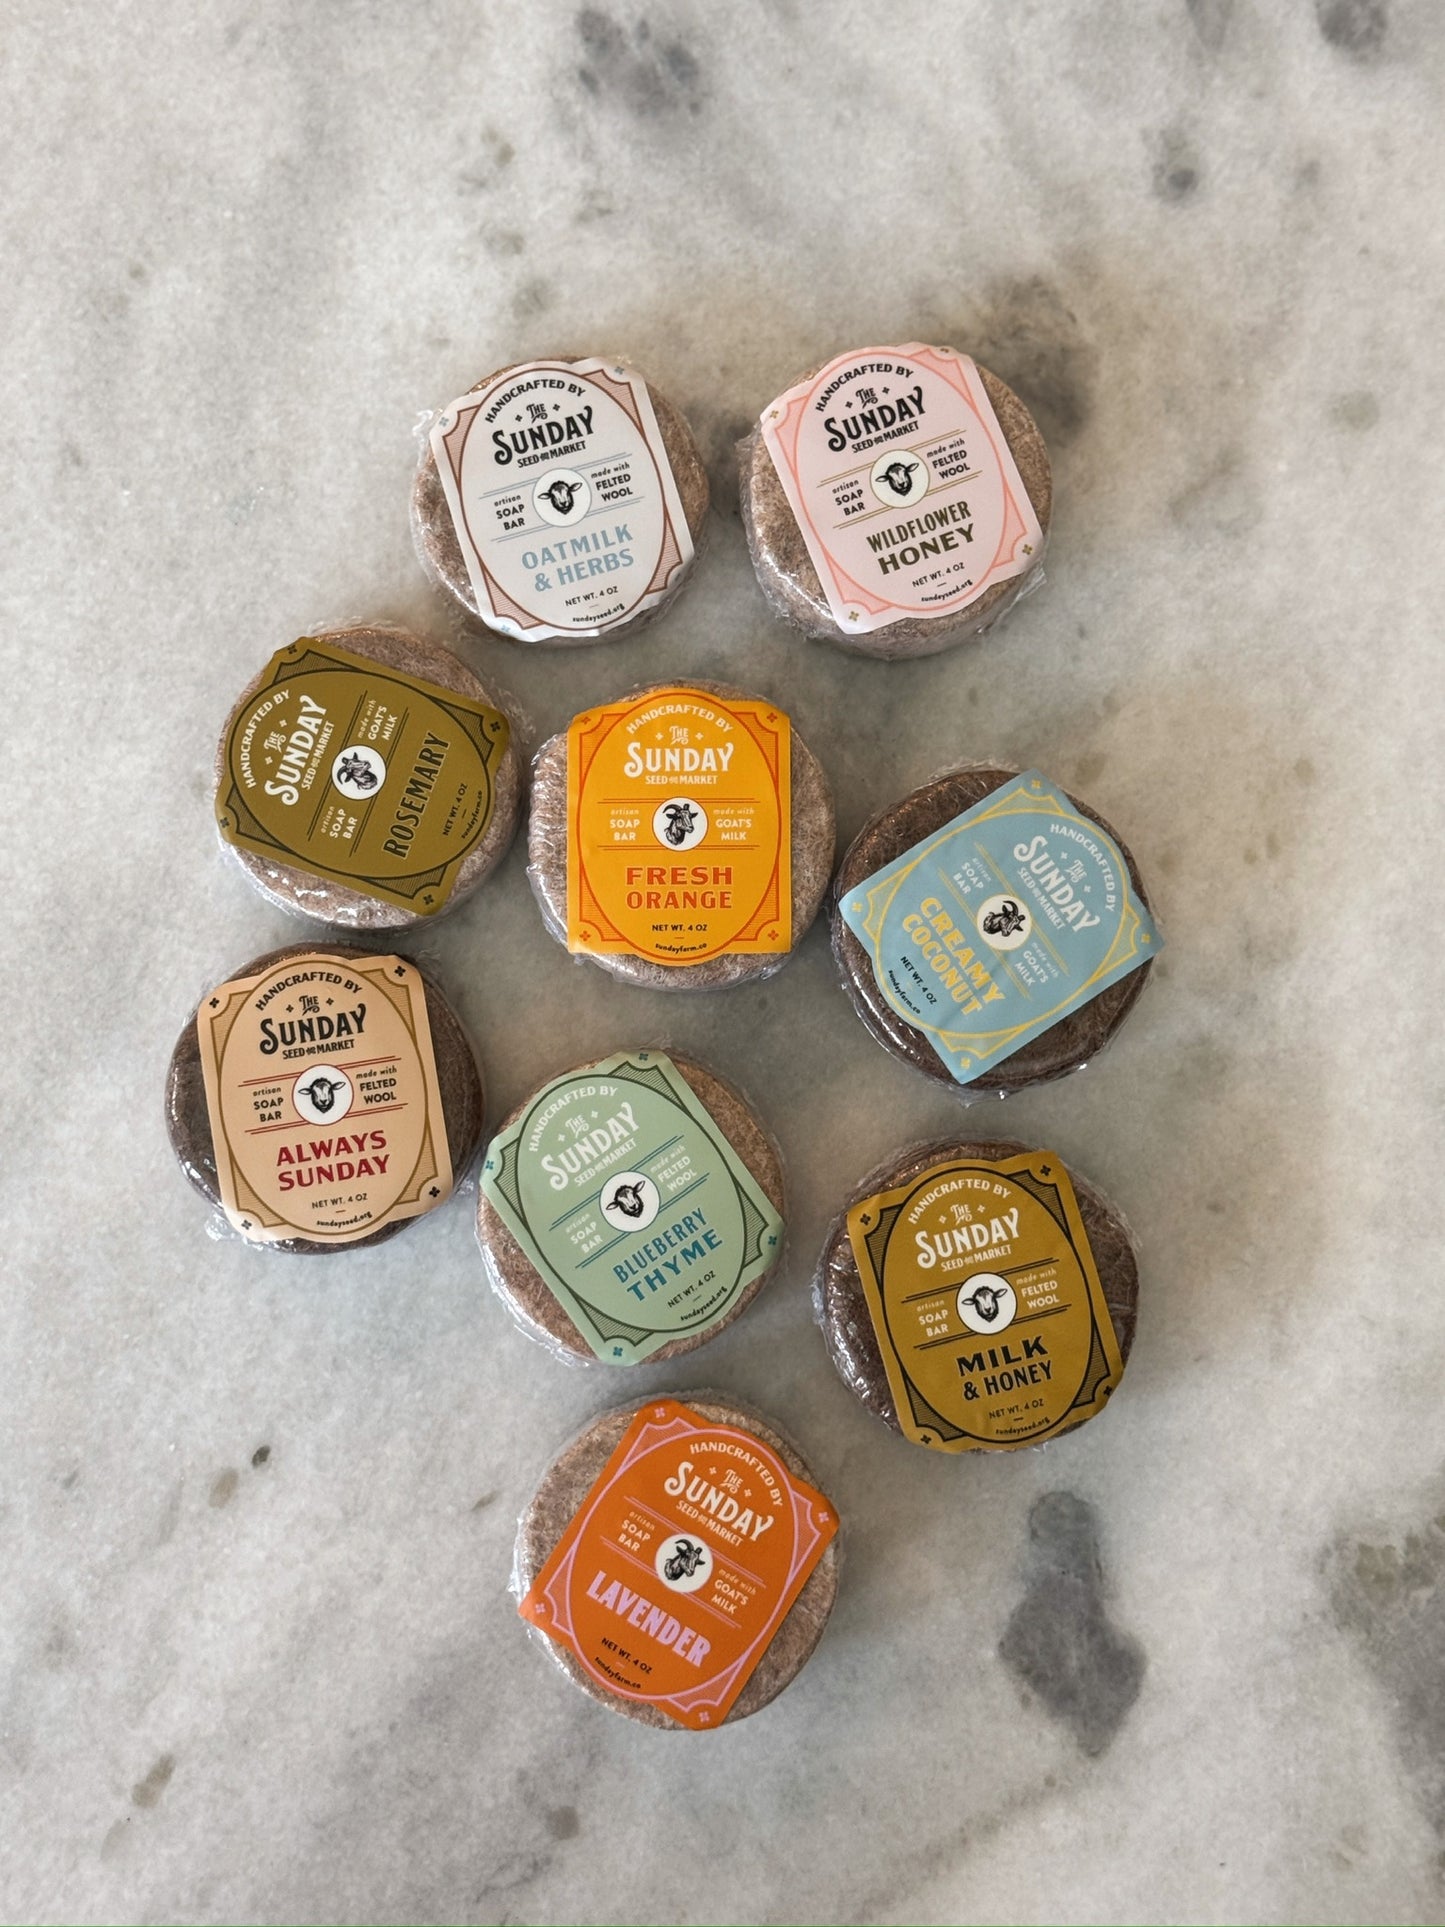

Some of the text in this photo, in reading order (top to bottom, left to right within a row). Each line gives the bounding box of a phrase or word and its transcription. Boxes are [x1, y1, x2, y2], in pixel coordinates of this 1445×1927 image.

[485, 379, 586, 423] HANDCRAFTED BY
[815, 363, 914, 412] HANDCRAFTED BY
[824, 386, 926, 452] SUNDAY
[492, 405, 594, 465] SUNDAY
[851, 439, 874, 453] SEED
[884, 421, 919, 442] MARKET
[517, 454, 540, 468] SEED
[550, 441, 587, 458] MARKET
[932, 450, 967, 468] FELTED
[595, 473, 631, 490] FELTED
[939, 463, 970, 479] WOOL
[601, 487, 633, 502] WOOL
[835, 489, 864, 506] SOAP
[496, 504, 525, 519] SOAP
[843, 502, 866, 516] BAR
[503, 518, 525, 530] BAR
[866, 501, 972, 552] WILDFLOWER
[521, 524, 633, 569] OATMILK
[877, 523, 974, 575] HONEY
[534, 549, 634, 592] & HERBS
[912, 562, 965, 587] NET WT. 4 OZ
[565, 586, 618, 606] NET WT. OZ
[921, 579, 973, 602] sundayseed.org
[572, 604, 625, 623] sundayseed.org
[368, 705, 388, 740] GOAT'S
[382, 715, 398, 740] MILK
[626, 705, 733, 734] HANDCRAFTED BY
[241, 689, 290, 788] HANDCRAFTED BY
[264, 695, 327, 806] SUNDAY
[301, 768, 318, 790] SEED
[316, 721, 335, 759] MARKET
[624, 742, 734, 778] SUNDAY
[645, 775, 667, 784] SEED
[679, 775, 717, 784] MARKET
[383, 732, 449, 859] ROSEMARY
[330, 808, 347, 838] SOAP
[443, 783, 468, 836] NET WT. OZ
[343, 817, 358, 839] BAR
[610, 819, 640, 829] SOAP
[614, 832, 636, 841] BAR
[715, 819, 752, 828] GOAT'S
[721, 832, 746, 841] MILK
[626, 867, 733, 886] FRESH
[961, 862, 984, 890] SOAP
[1050, 823, 1116, 912] HANDCRAFTED BY
[953, 872, 971, 895] BAR
[1013, 835, 1100, 933] SUNDAY
[626, 891, 733, 909] ORANGE
[1017, 867, 1066, 930] SEED MARKET
[655, 942, 707, 954] sundayfarm.co
[920, 897, 1006, 1004] CREAMY
[902, 913, 983, 1016] COCONUT
[1014, 961, 1036, 987] MILK
[1022, 950, 1049, 984] GOAT'S
[256, 972, 362, 1011] HANDCRAFTED BY
[900, 956, 938, 1005] NET WT. OZ
[259, 1003, 367, 1055] SUNDAY
[282, 1048, 305, 1060] SEED
[316, 1039, 355, 1054] MARKET
[356, 1066, 397, 1079] made with
[360, 1078, 397, 1092] FELTED
[253, 1087, 281, 1097] artisan
[253, 1098, 283, 1110] SOAP
[364, 1091, 397, 1104] WOOL
[259, 1111, 282, 1122] BAR
[529, 1085, 618, 1152] HANDCRAFTED BY
[276, 1130, 387, 1167] ALWAYS
[541, 1102, 639, 1191] SUNDAY
[278, 1154, 390, 1191] SUNDAY
[574, 1138, 637, 1187] SEED MARKET
[657, 1156, 691, 1182] FELTED
[667, 1169, 697, 1191] WOOL
[312, 1201, 328, 1209] NET
[330, 1197, 345, 1206] WT.
[355, 1193, 368, 1202] OZ
[908, 1179, 1011, 1224] HANDCRAFTED BY
[316, 1211, 373, 1229] sundayseed.org
[570, 1221, 597, 1244] SOAP
[581, 1235, 603, 1254] BAR
[613, 1207, 709, 1283] BLUEBERRY
[915, 1207, 1019, 1269] SUNDAY
[627, 1229, 723, 1302] THYME
[941, 1259, 964, 1272] SEED
[974, 1245, 1012, 1262] MARKET
[668, 1271, 716, 1308] NET WT. OZ
[1021, 1280, 1058, 1297] FELTED
[1027, 1294, 1059, 1309] WOOL
[919, 1309, 949, 1326] SOAP
[926, 1325, 949, 1336] BAR
[956, 1336, 1049, 1377] MILK
[963, 1360, 1052, 1401] & HONEY
[989, 1399, 1044, 1419] NET WT. OZ
[690, 1442, 783, 1507] HANDCRAFTED BY
[664, 1461, 775, 1542] SUNDAY
[621, 1520, 651, 1542] SOAP
[676, 1500, 698, 1520] SEED
[705, 1519, 743, 1547] MARKET
[618, 1534, 640, 1551] BAR
[711, 1593, 738, 1614] MILK
[714, 1579, 749, 1605] GOAT'S
[586, 1570, 712, 1668] LAVENDER
[601, 1637, 653, 1674] NET WT. OZ
